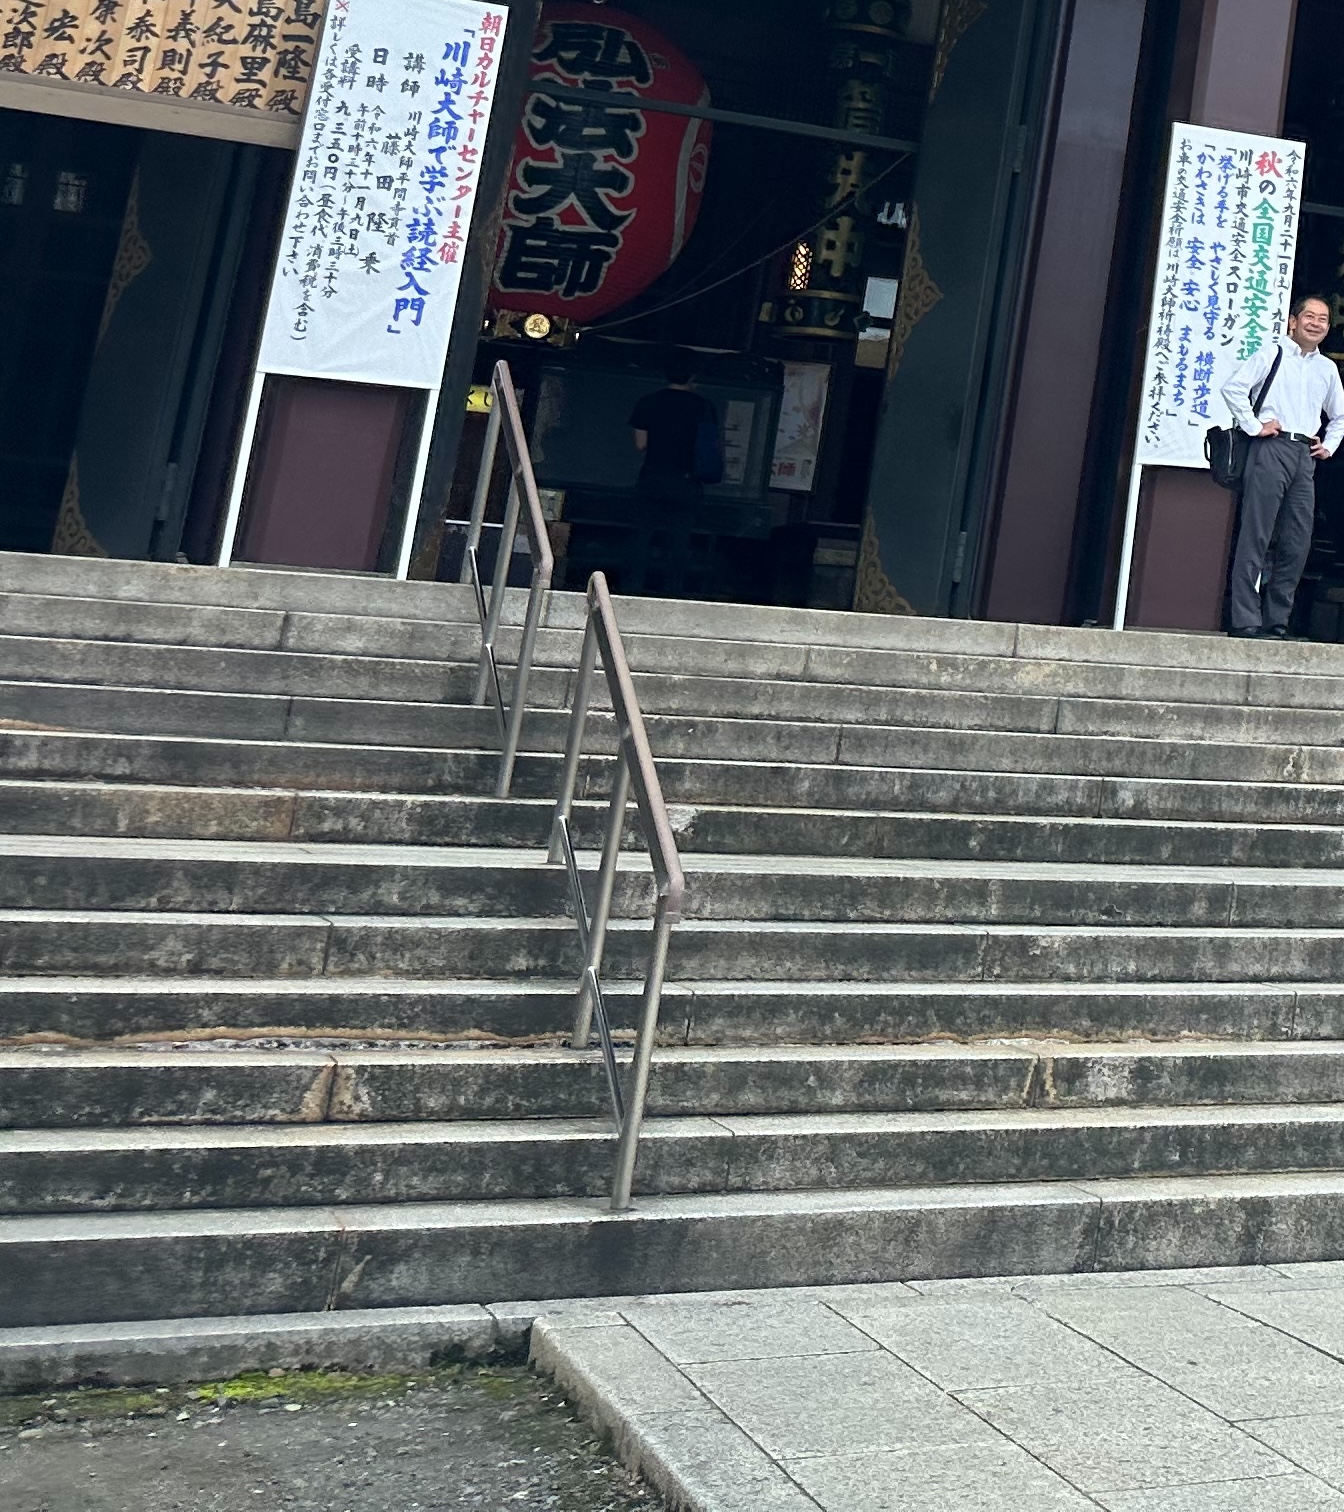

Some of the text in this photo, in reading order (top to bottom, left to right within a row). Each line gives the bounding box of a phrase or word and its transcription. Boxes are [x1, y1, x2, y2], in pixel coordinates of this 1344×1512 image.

[337, 43, 362, 91] 受講料
[366, 46, 390, 94] 日時
[400, 52, 427, 99] 講師
[436, 10, 503, 264] 朝日カルチャーセンター主催
[493, 19, 655, 302] 弘法大師
[1203, 240, 1227, 342] やさしく見守る
[1220, 148, 1254, 348] 川崎市交通安全スローガン
